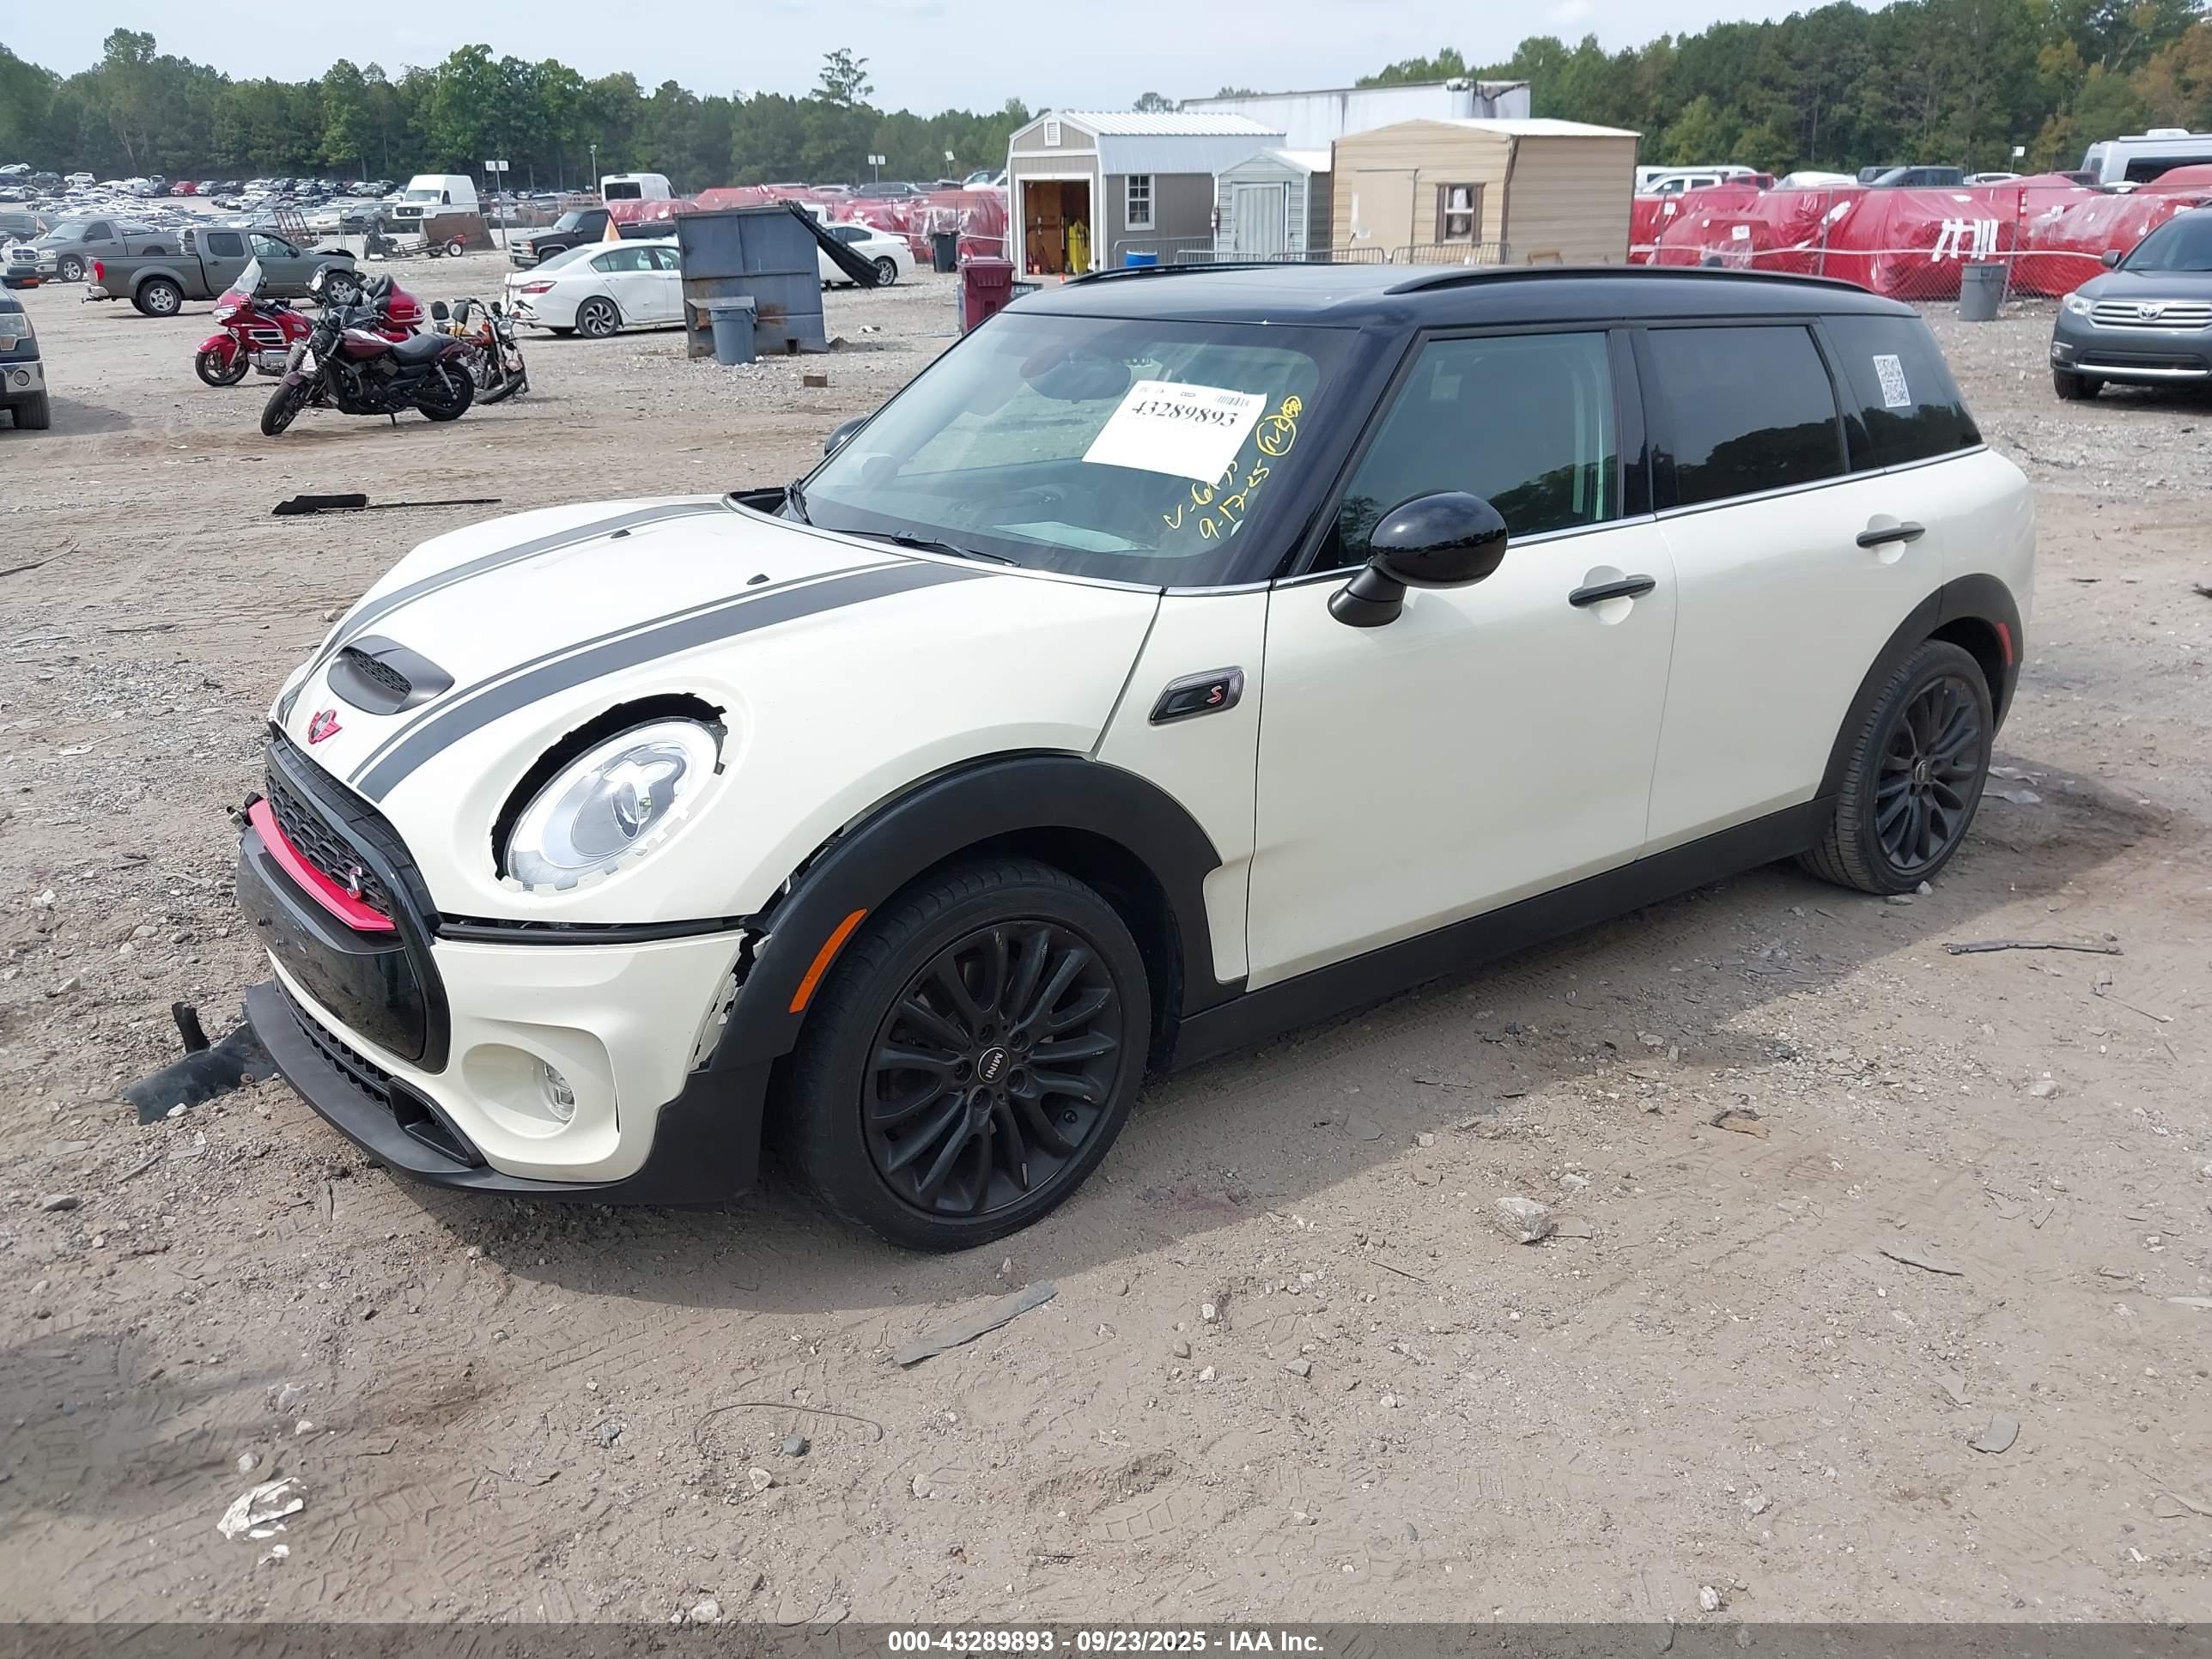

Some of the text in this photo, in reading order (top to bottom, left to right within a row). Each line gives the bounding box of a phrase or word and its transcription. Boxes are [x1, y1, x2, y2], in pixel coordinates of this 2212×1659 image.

[1132, 400, 1239, 428] 43289893
[1205, 684, 1223, 704] S
[985, 1052, 1004, 1079] MINI
